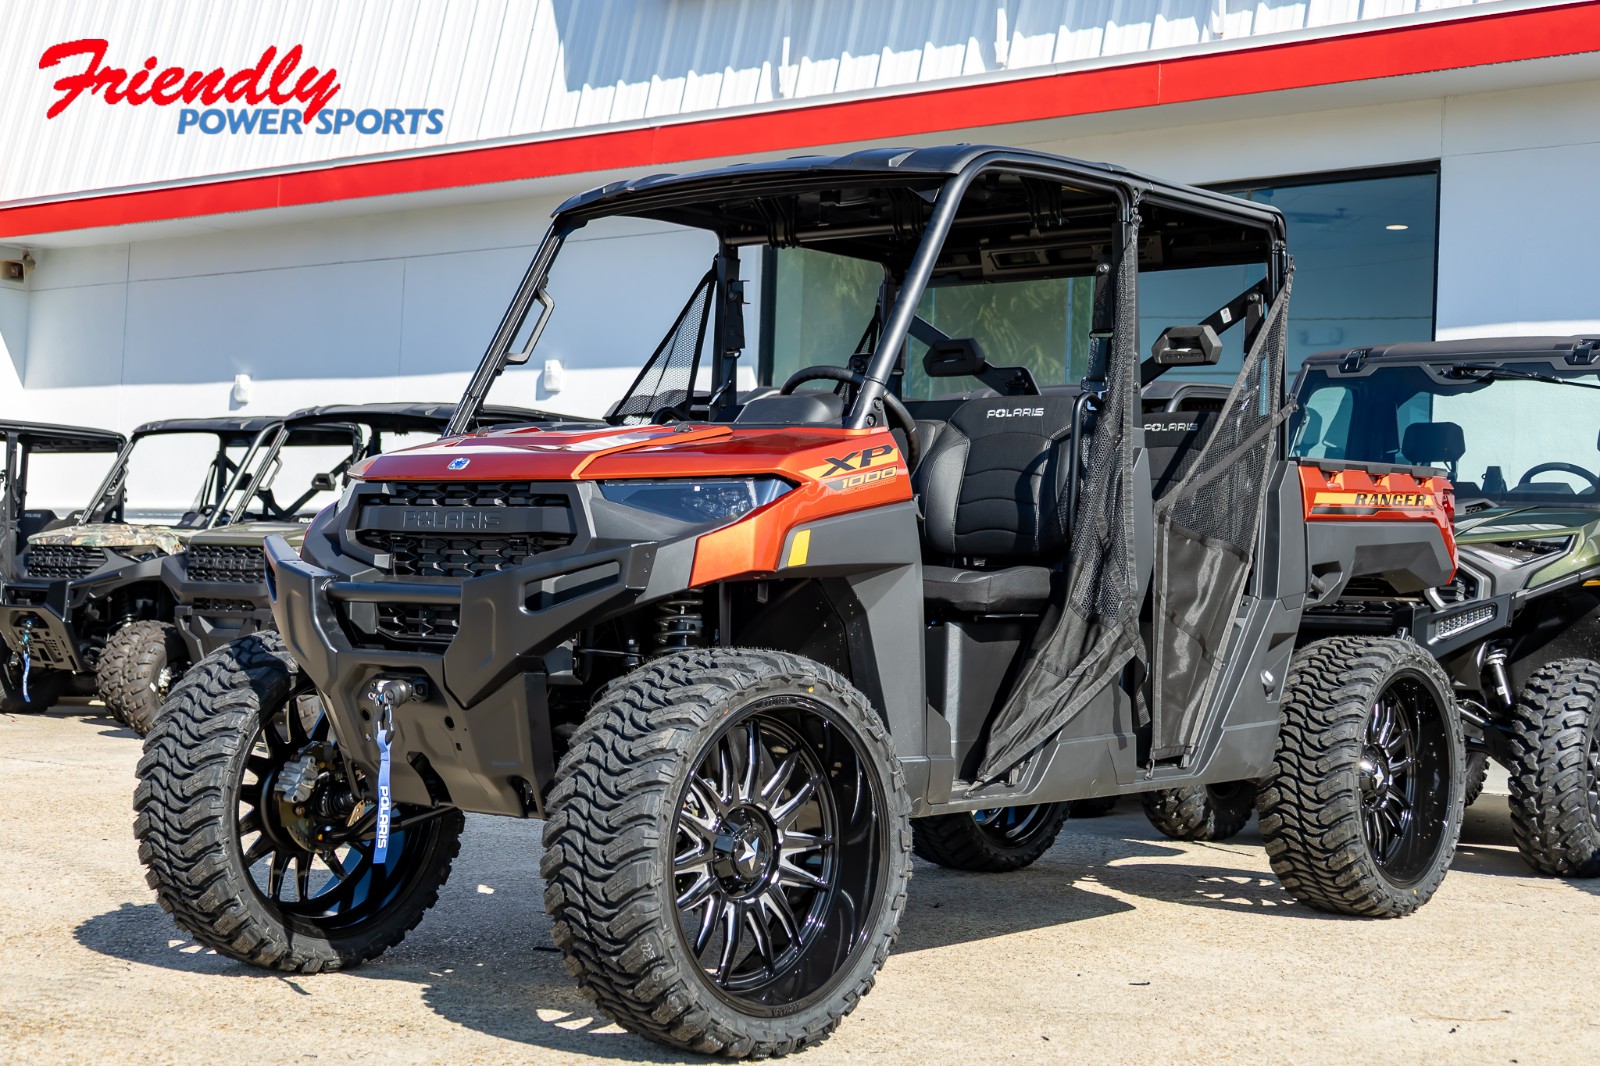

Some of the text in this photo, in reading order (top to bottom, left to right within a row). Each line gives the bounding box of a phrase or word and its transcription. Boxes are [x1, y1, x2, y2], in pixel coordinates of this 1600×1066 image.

[986, 407, 1045, 418] POLARIS
[1144, 422, 1198, 432] POLARIS
[820, 444, 894, 478] XP
[842, 466, 897, 489] 1000
[1354, 493, 1427, 506] RANGER
[403, 511, 500, 528] POLARIS
[377, 785, 390, 849] POLARIS
